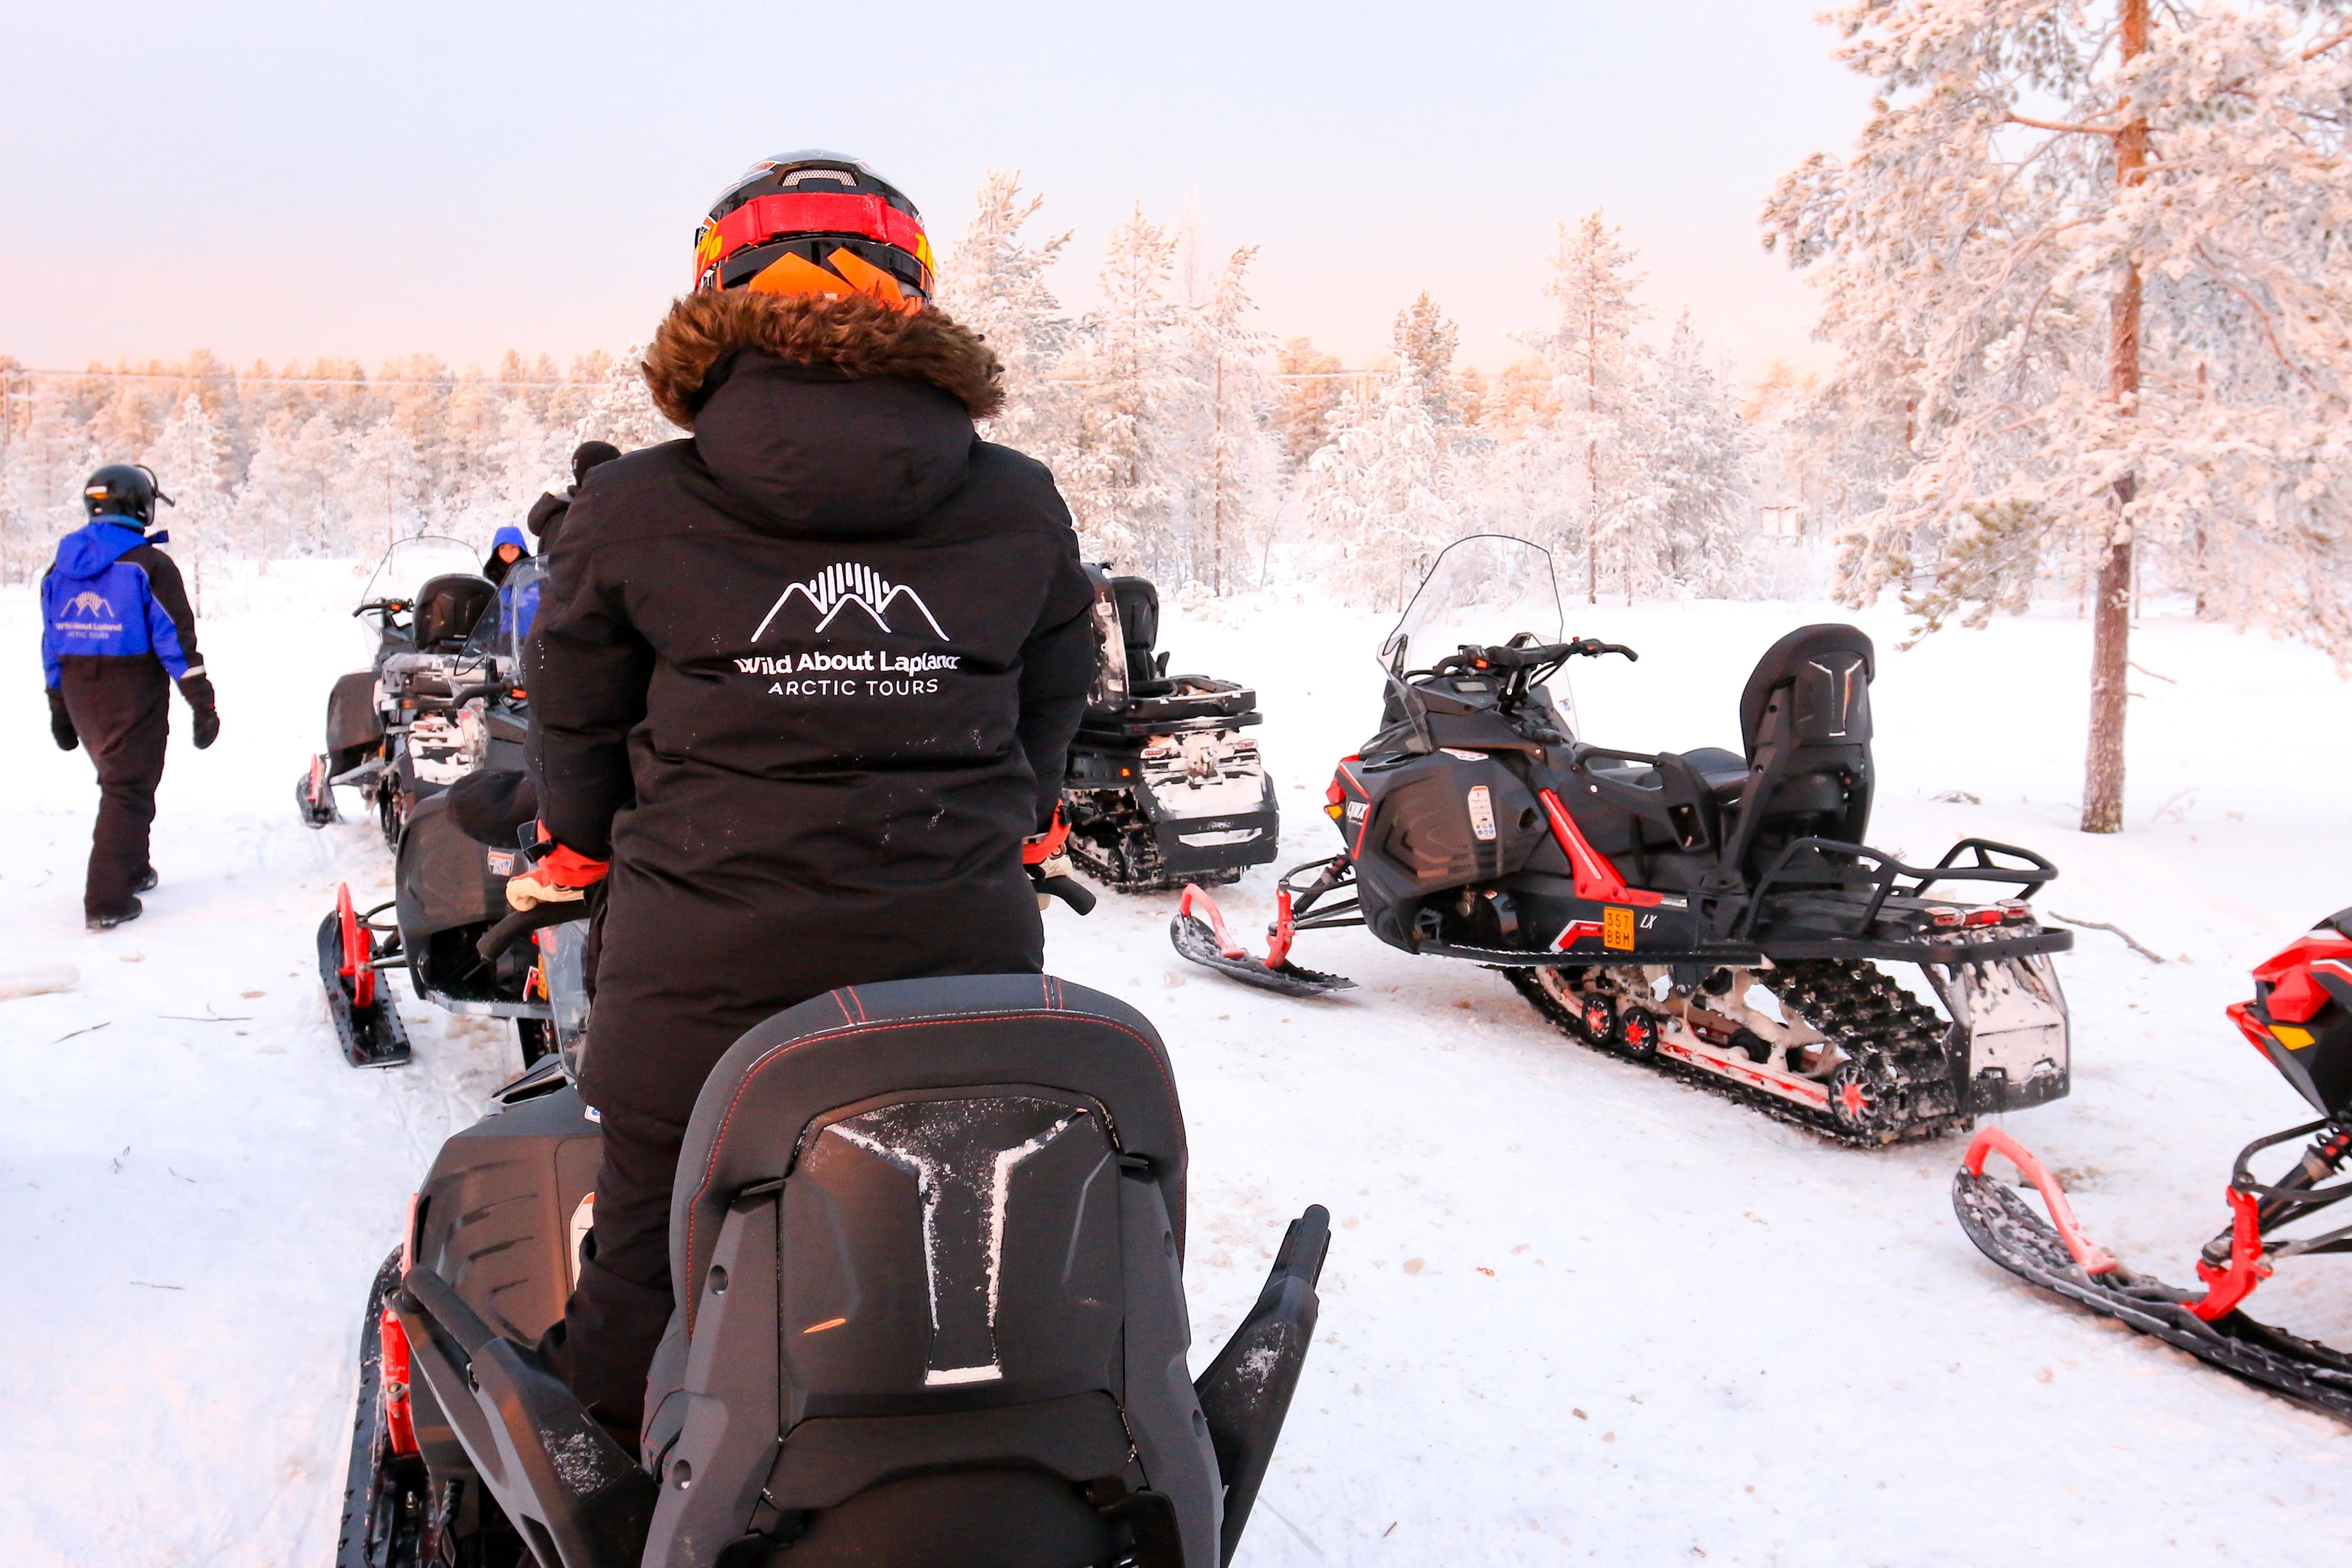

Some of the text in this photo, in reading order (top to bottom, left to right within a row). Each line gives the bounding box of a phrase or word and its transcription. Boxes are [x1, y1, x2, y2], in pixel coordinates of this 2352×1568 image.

[733, 654, 793, 675] Wild
[796, 650, 875, 671] About
[768, 678, 938, 696] ARCTIC TOURS
[1607, 913, 1629, 929] 357
[1639, 914, 1658, 929] LX
